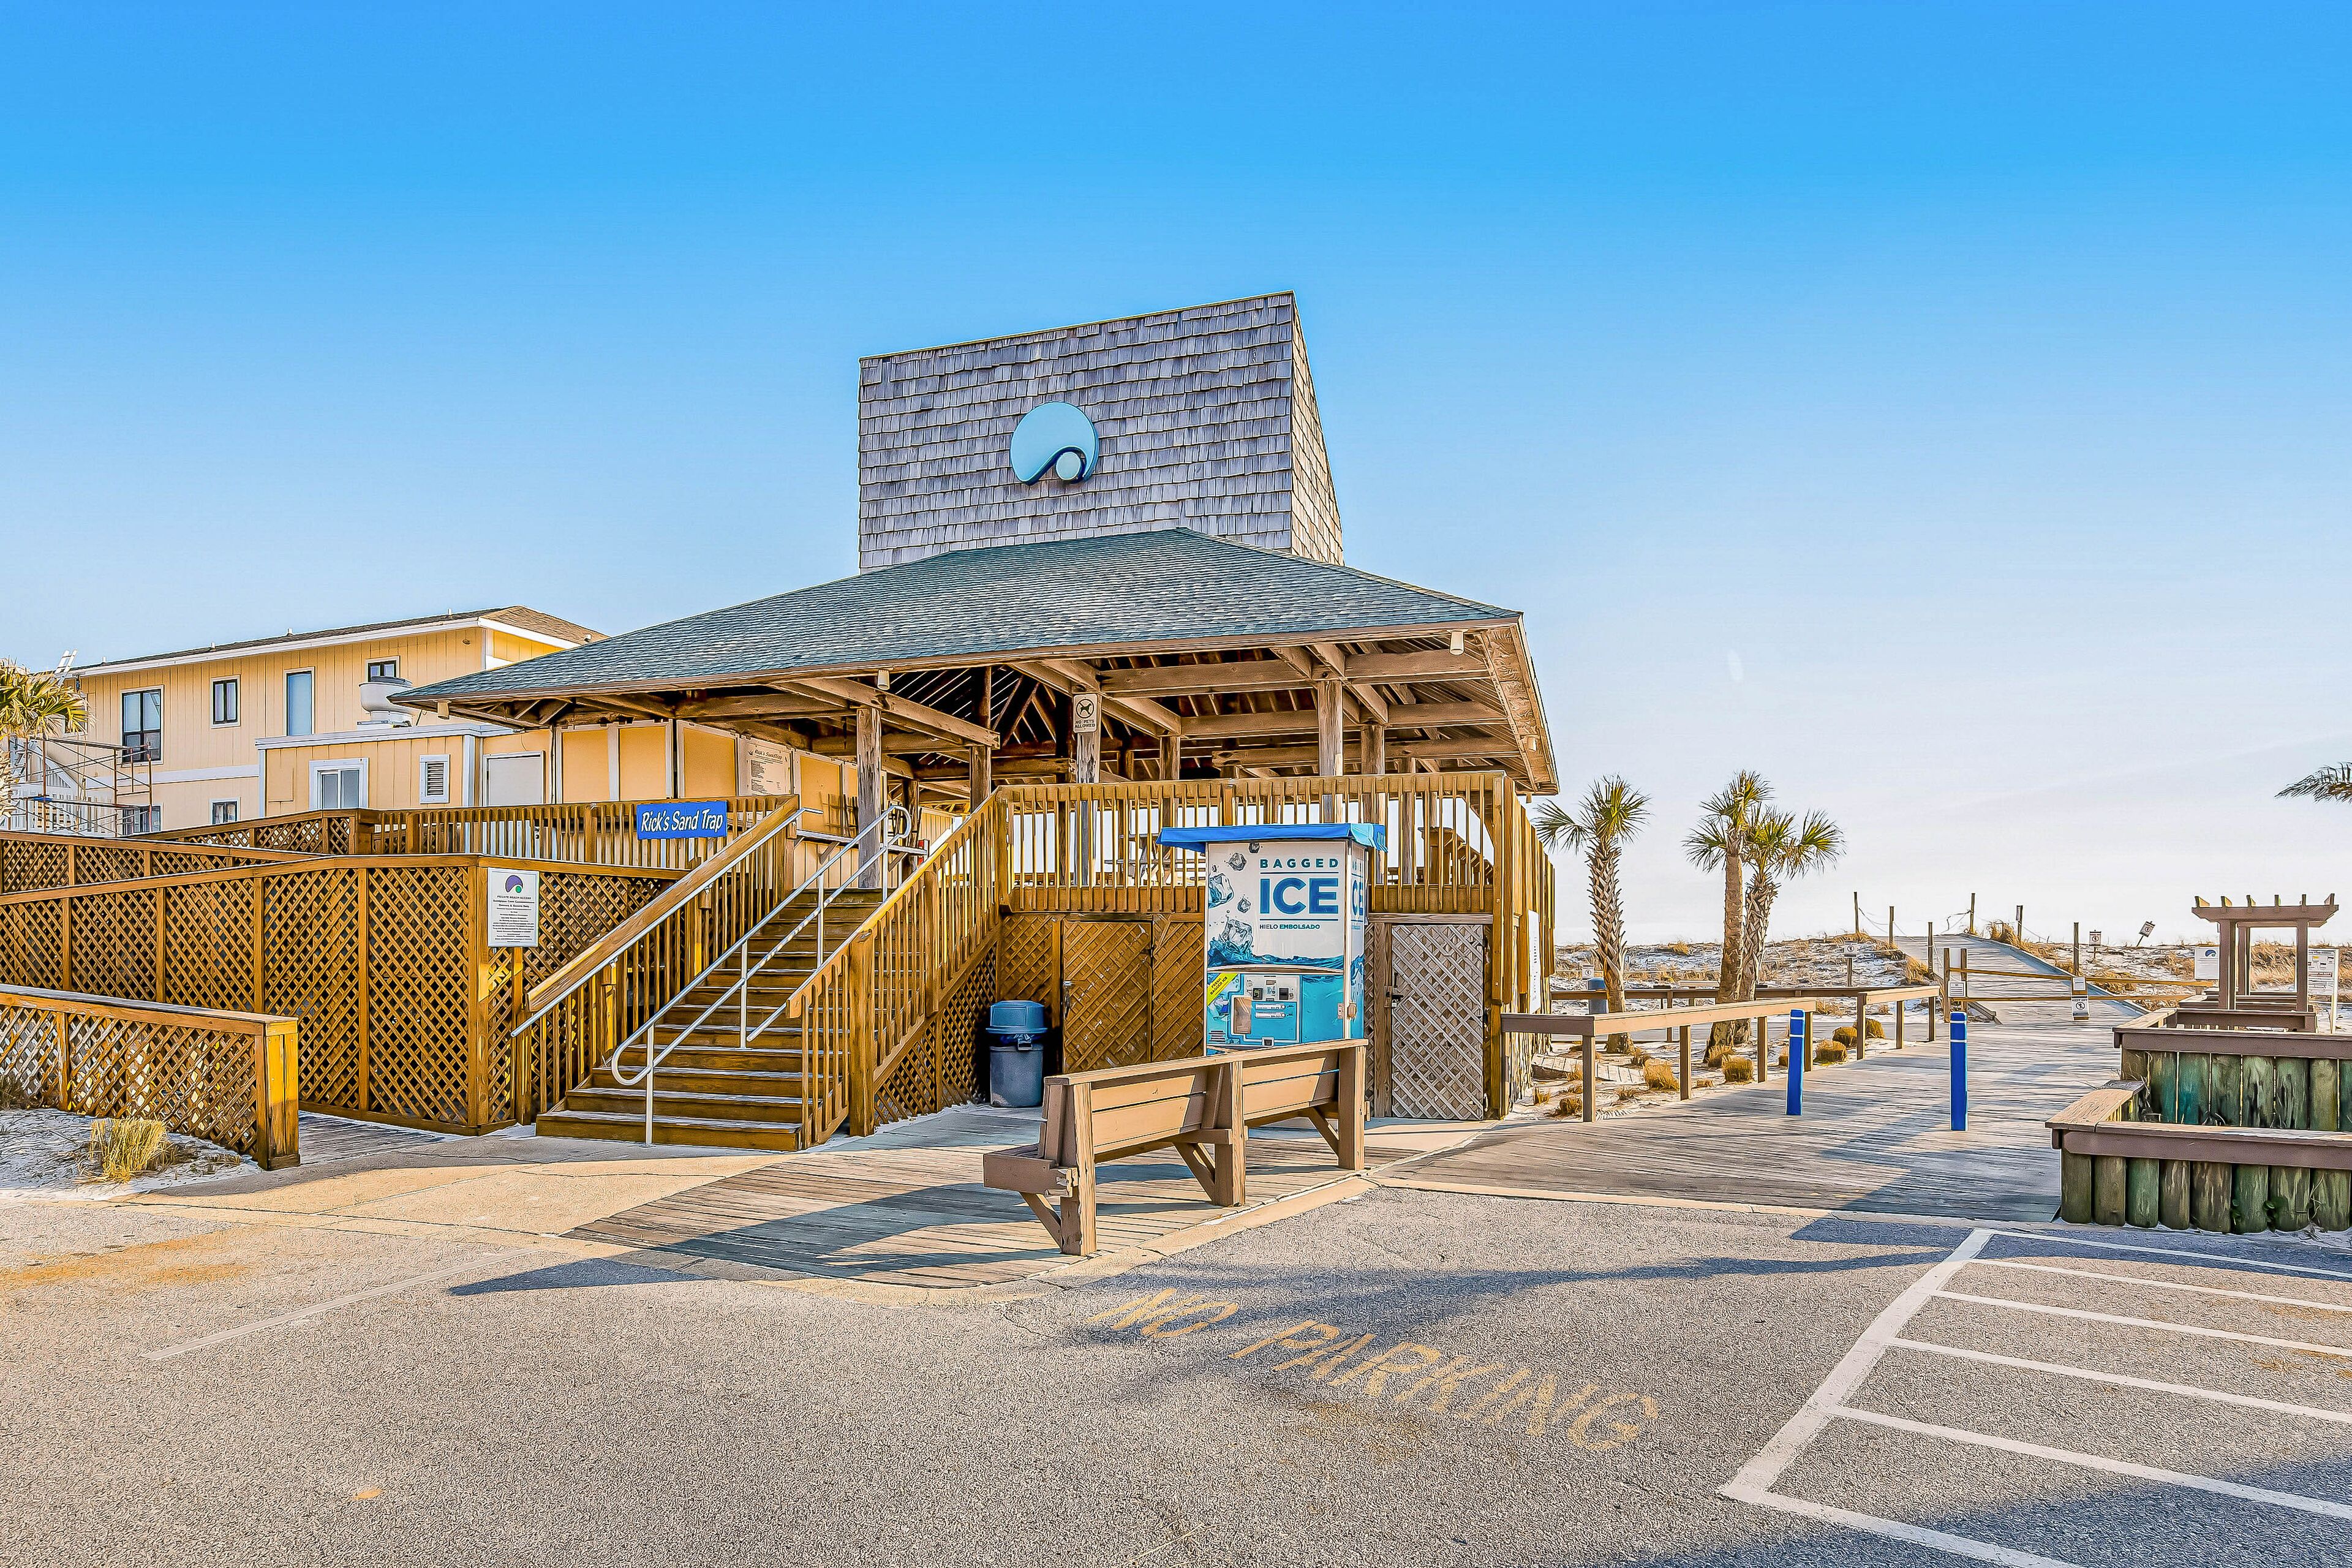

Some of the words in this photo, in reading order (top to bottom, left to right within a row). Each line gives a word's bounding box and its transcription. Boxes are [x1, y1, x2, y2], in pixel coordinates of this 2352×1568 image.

[641, 810, 670, 832] Rick's
[671, 809, 700, 831] Sand
[701, 808, 723, 833] Trap
[1259, 858, 1340, 869] BAGGED
[1259, 877, 1340, 914] ICE
[1088, 1287, 1239, 1340] NO
[1227, 1319, 1659, 1451] PARKING
